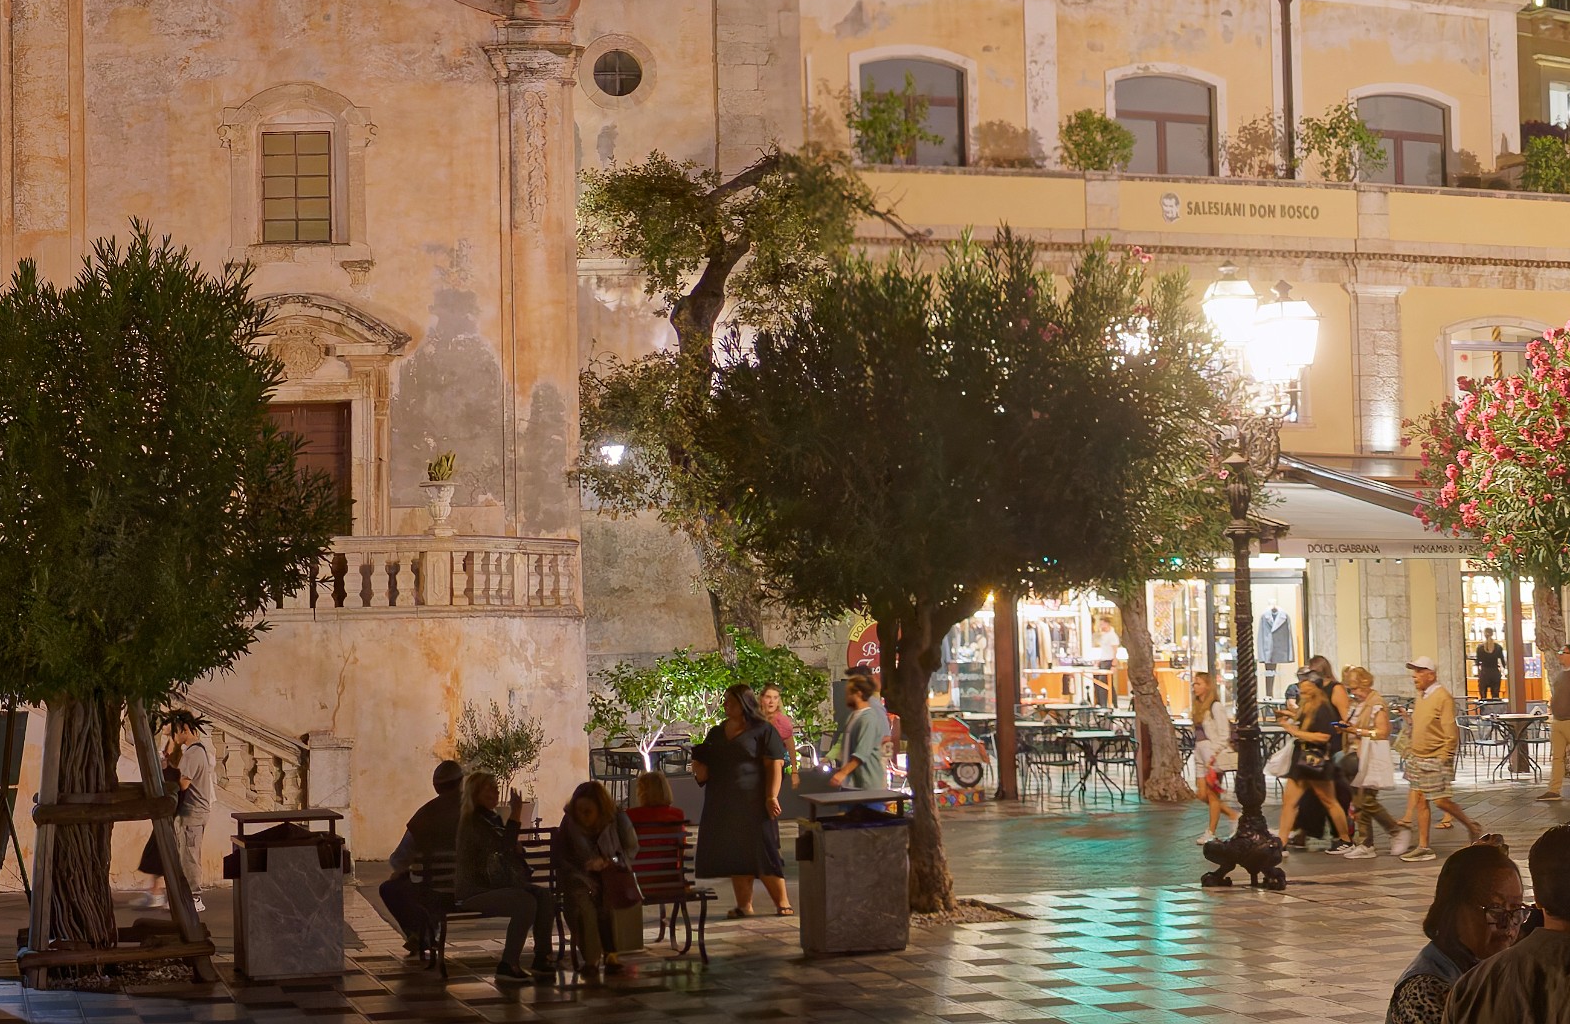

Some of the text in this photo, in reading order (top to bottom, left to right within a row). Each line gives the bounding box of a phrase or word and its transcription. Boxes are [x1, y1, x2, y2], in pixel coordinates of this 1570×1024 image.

[1186, 200, 1320, 220] SALESIANI DON BOSCO
[1412, 544, 1455, 554] MOCAMBO
